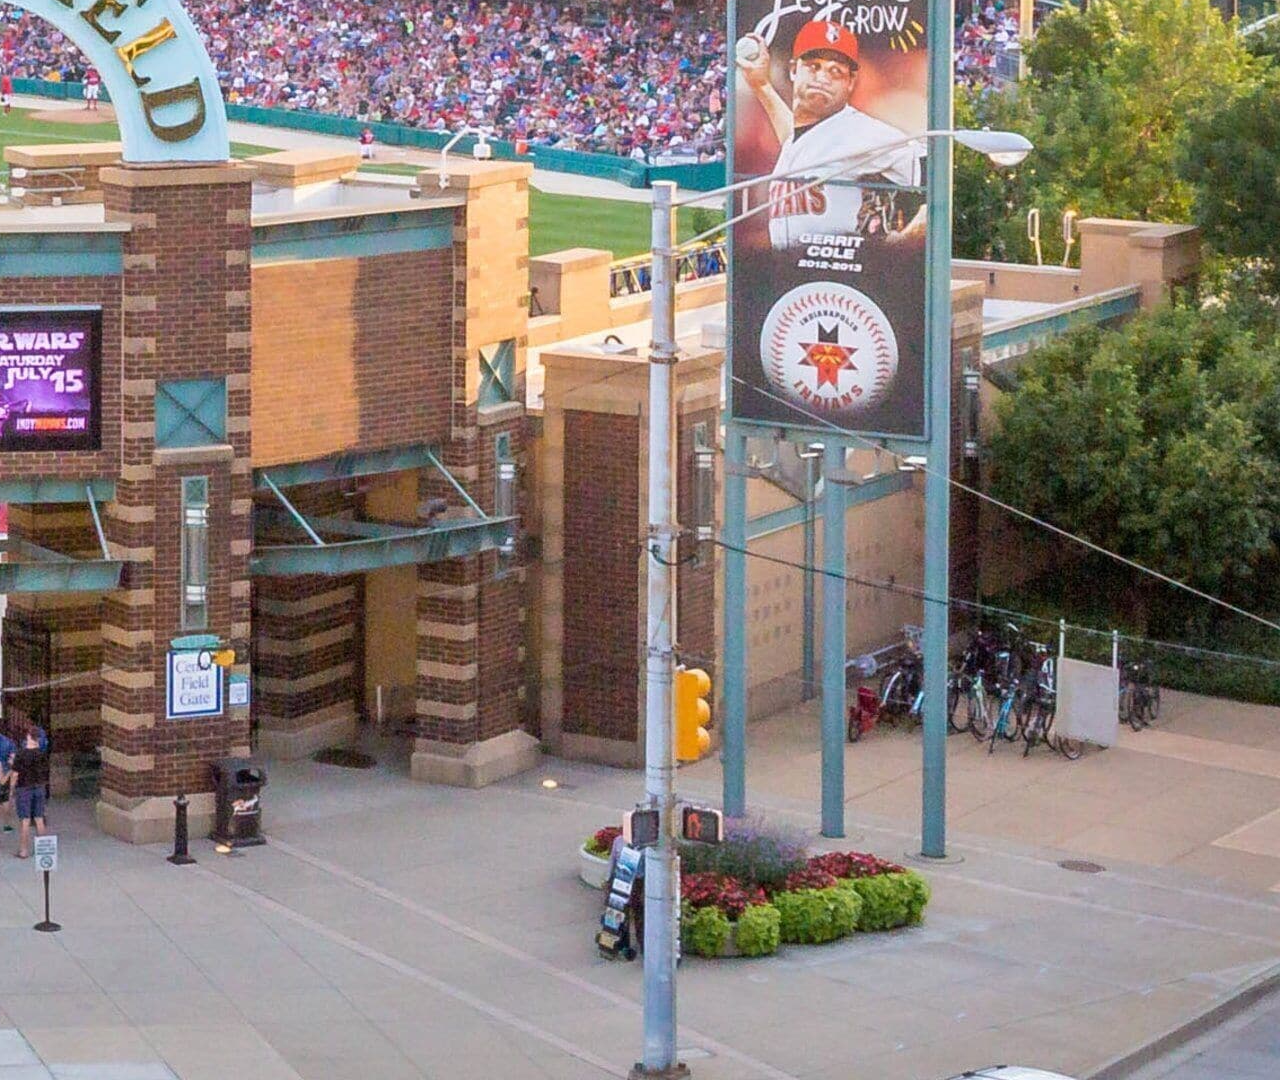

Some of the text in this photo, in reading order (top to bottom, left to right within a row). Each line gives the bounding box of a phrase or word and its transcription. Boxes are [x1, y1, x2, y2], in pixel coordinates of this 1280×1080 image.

[841, 5, 908, 35] GROW
[799, 232, 865, 249] GERRIT
[806, 245, 856, 260] COLE
[798, 259, 863, 273] 2012-2013
[799, 309, 859, 332] INDIANAPOLIS
[13, 332, 85, 351] WARS
[4, 367, 85, 393] JULY 15
[793, 379, 864, 410] INDIANS
[181, 675, 209, 690] Field
[180, 694, 210, 706] Gate
